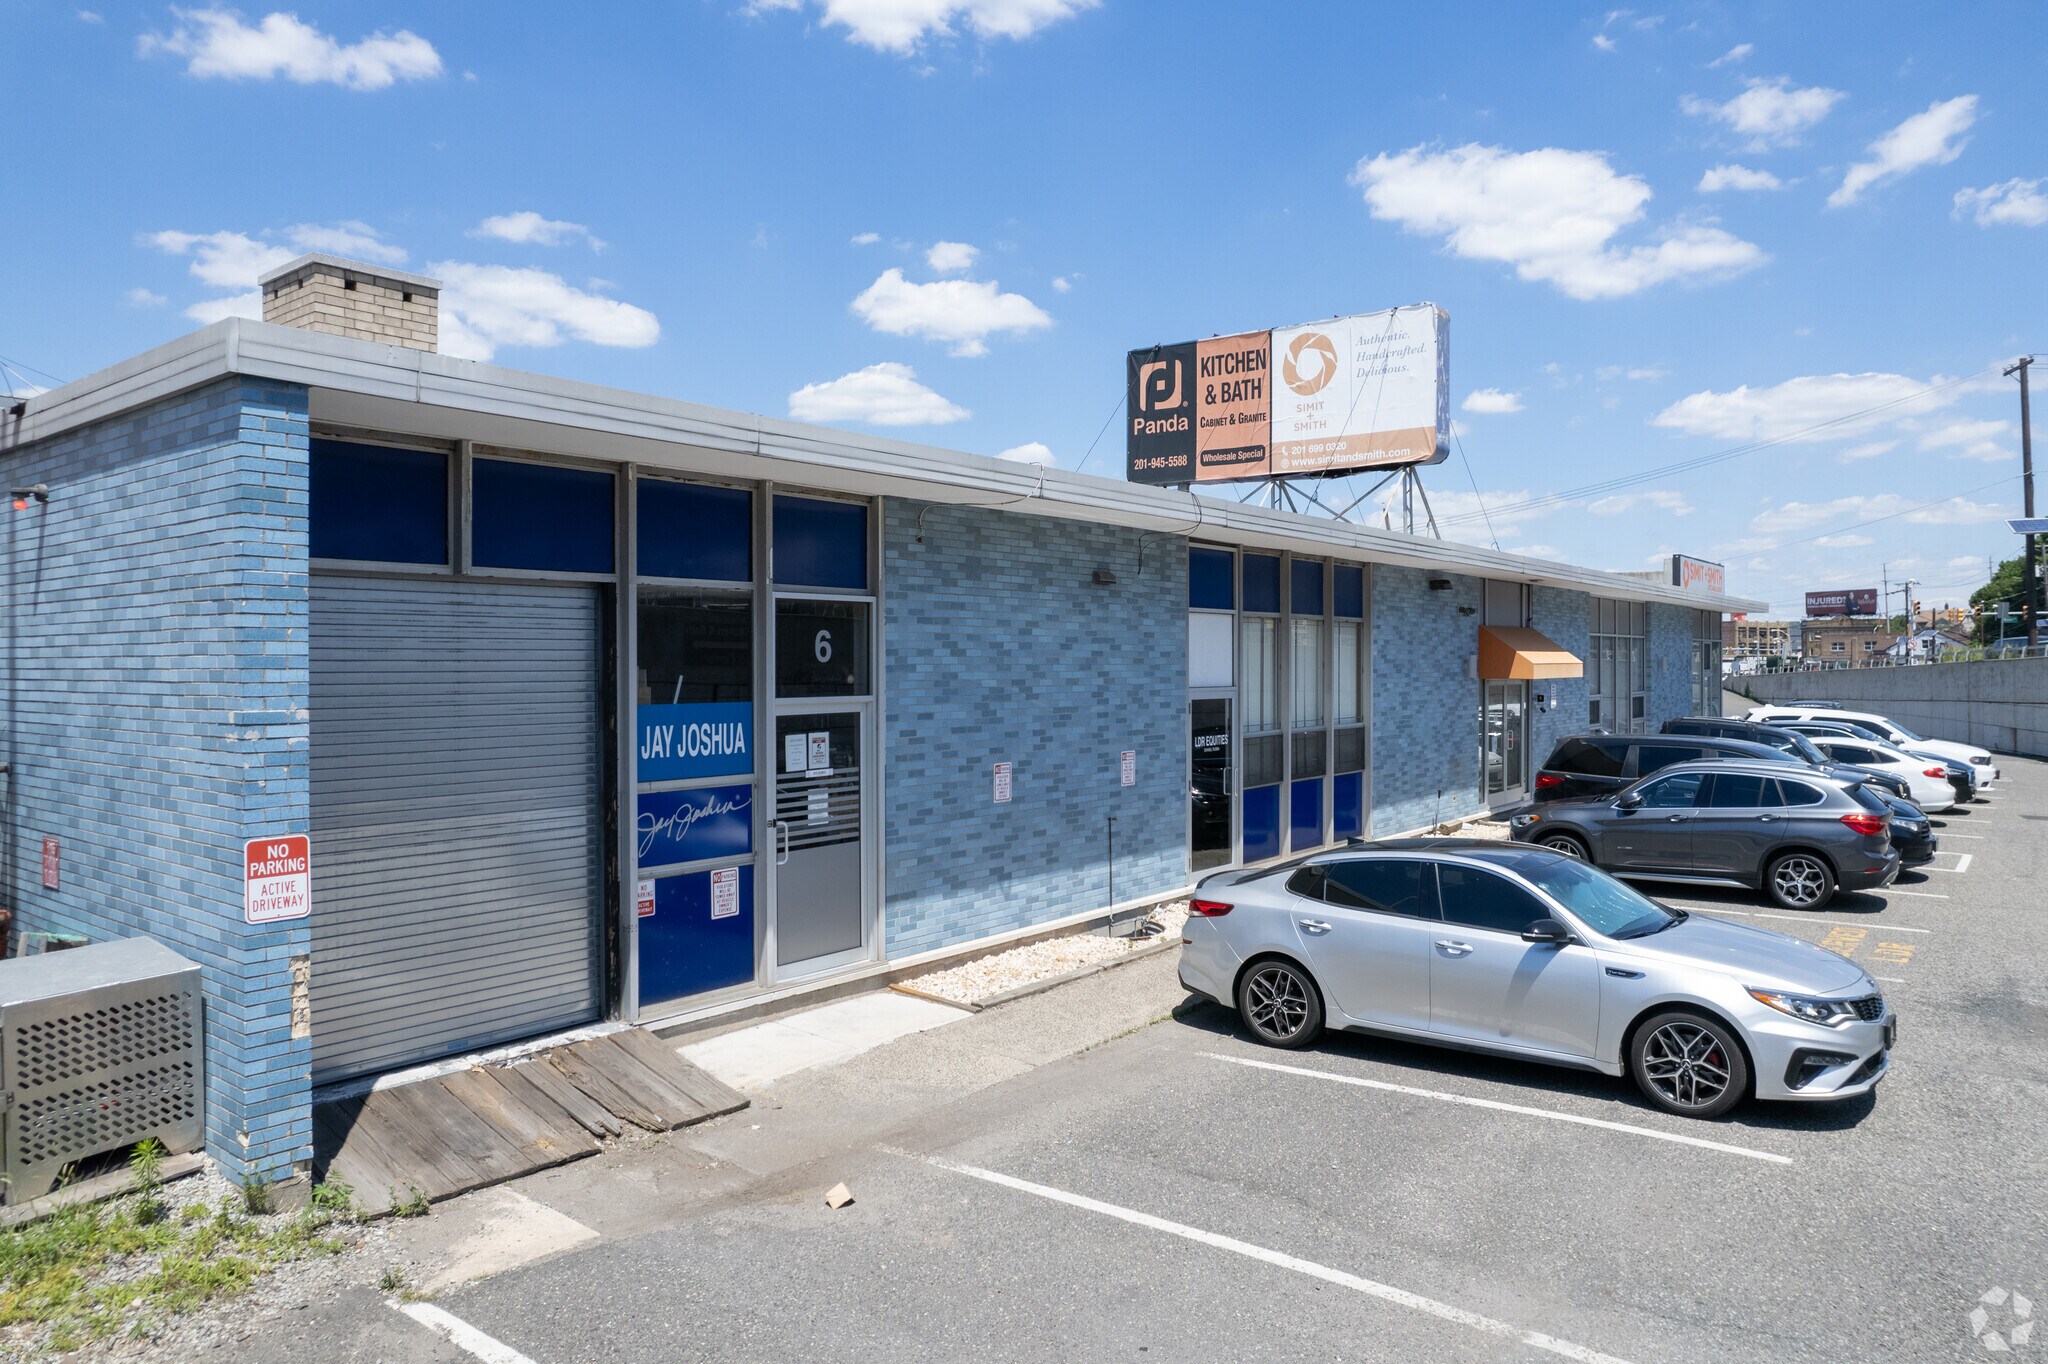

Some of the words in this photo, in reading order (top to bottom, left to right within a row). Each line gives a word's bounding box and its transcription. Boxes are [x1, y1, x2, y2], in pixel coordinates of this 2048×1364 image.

[1356, 343, 1427, 362] Handcrafted.
[1201, 348, 1267, 378] KITCHEN
[1205, 384, 1217, 405] &
[1221, 378, 1261, 403] BATH
[1296, 401, 1325, 413] SIMIT
[1134, 414, 1188, 436] Panda
[1229, 413, 1236, 425] &
[1294, 421, 1327, 432] SMITH
[1202, 452, 1237, 462] Wholesale
[1238, 449, 1263, 461] Special
[1291, 445, 1306, 455] 201
[1291, 447, 1411, 466] www.simitandsmith.com
[1134, 455, 1188, 470] 201-945-5588
[1807, 596, 1847, 605] INJURED?
[814, 630, 832, 663] 6
[641, 725, 674, 759] JAY
[677, 722, 746, 758] JOSHUA
[267, 844, 289, 859] NO
[250, 857, 306, 877] PARKING
[261, 880, 296, 896] ACTIVE
[252, 894, 304, 912] DRIVEWAY
